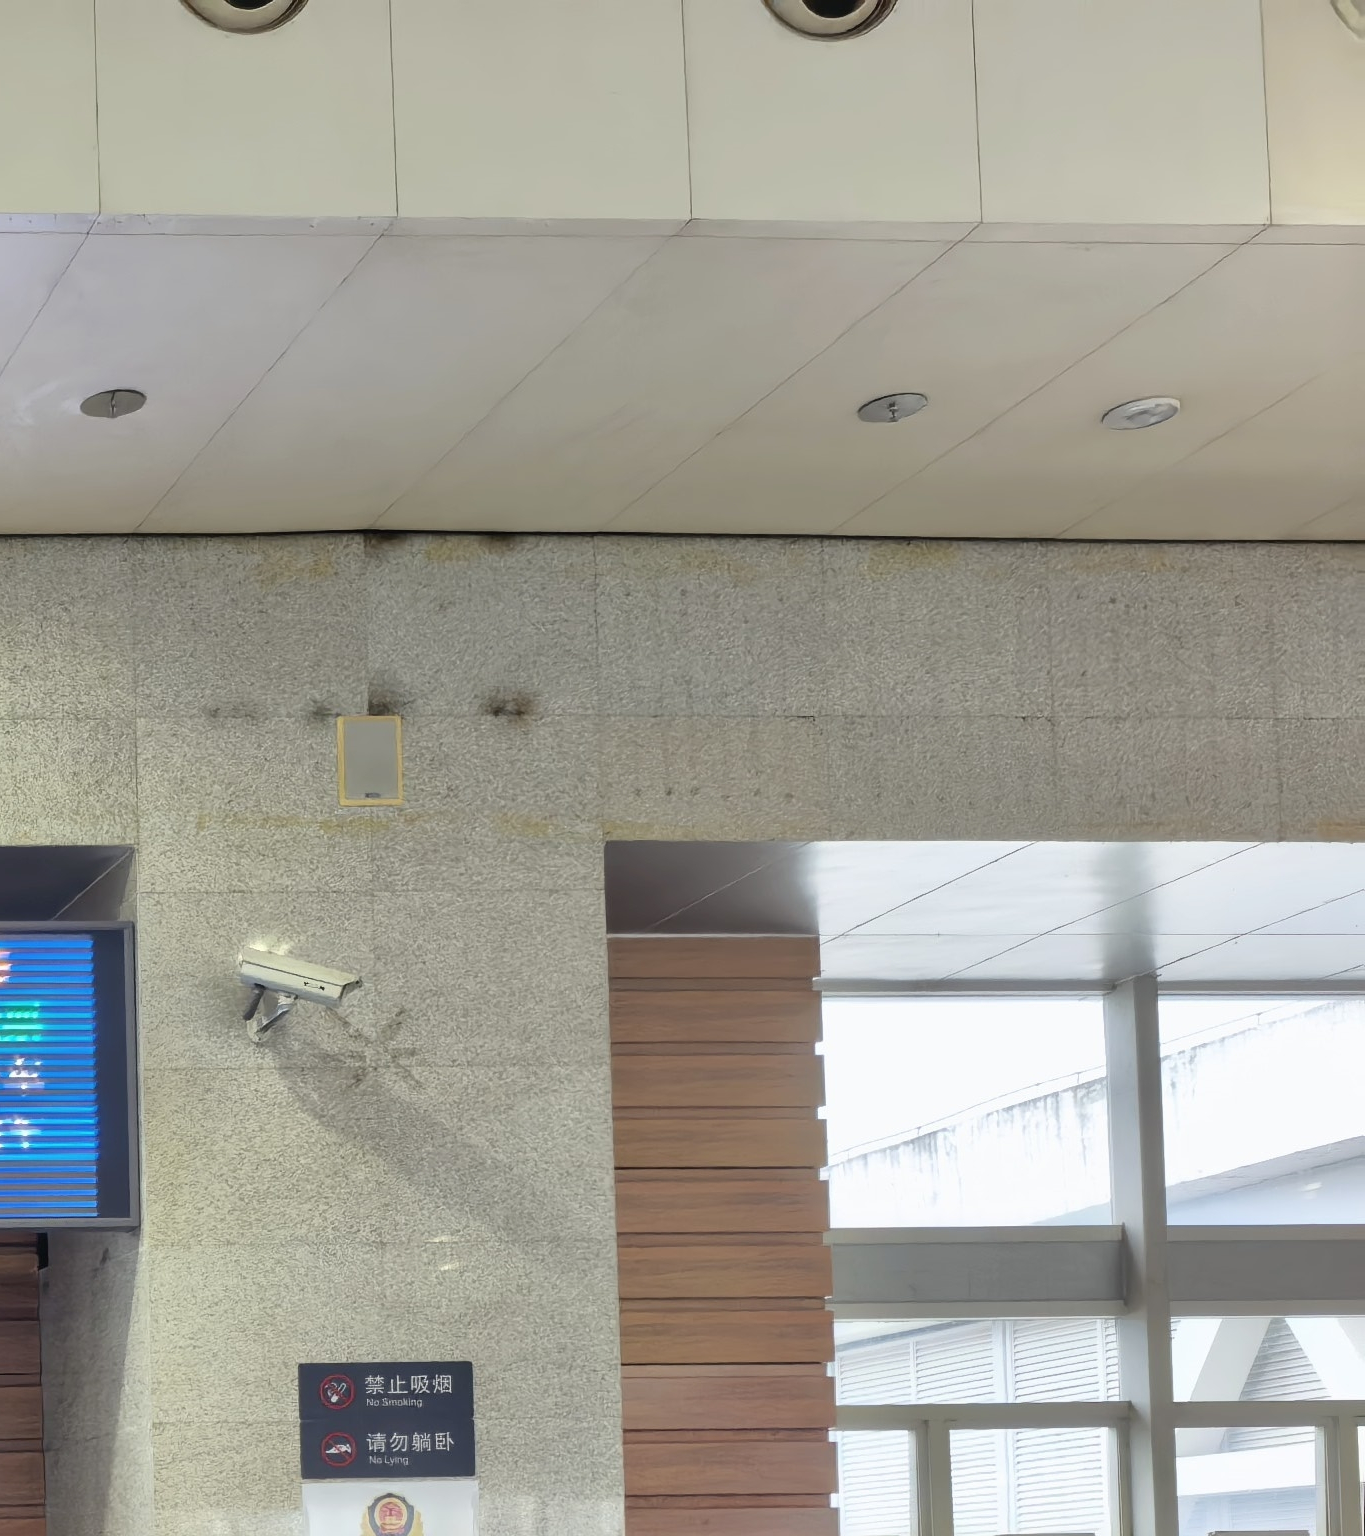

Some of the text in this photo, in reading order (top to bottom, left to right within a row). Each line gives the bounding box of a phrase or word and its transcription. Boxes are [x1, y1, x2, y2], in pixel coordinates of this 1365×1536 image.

[364, 1373, 453, 1395] 禁止吸烟
[366, 1397, 423, 1408] No Smoking
[366, 1431, 455, 1453] 请勿躺卧
[369, 1455, 409, 1466] No Lying
